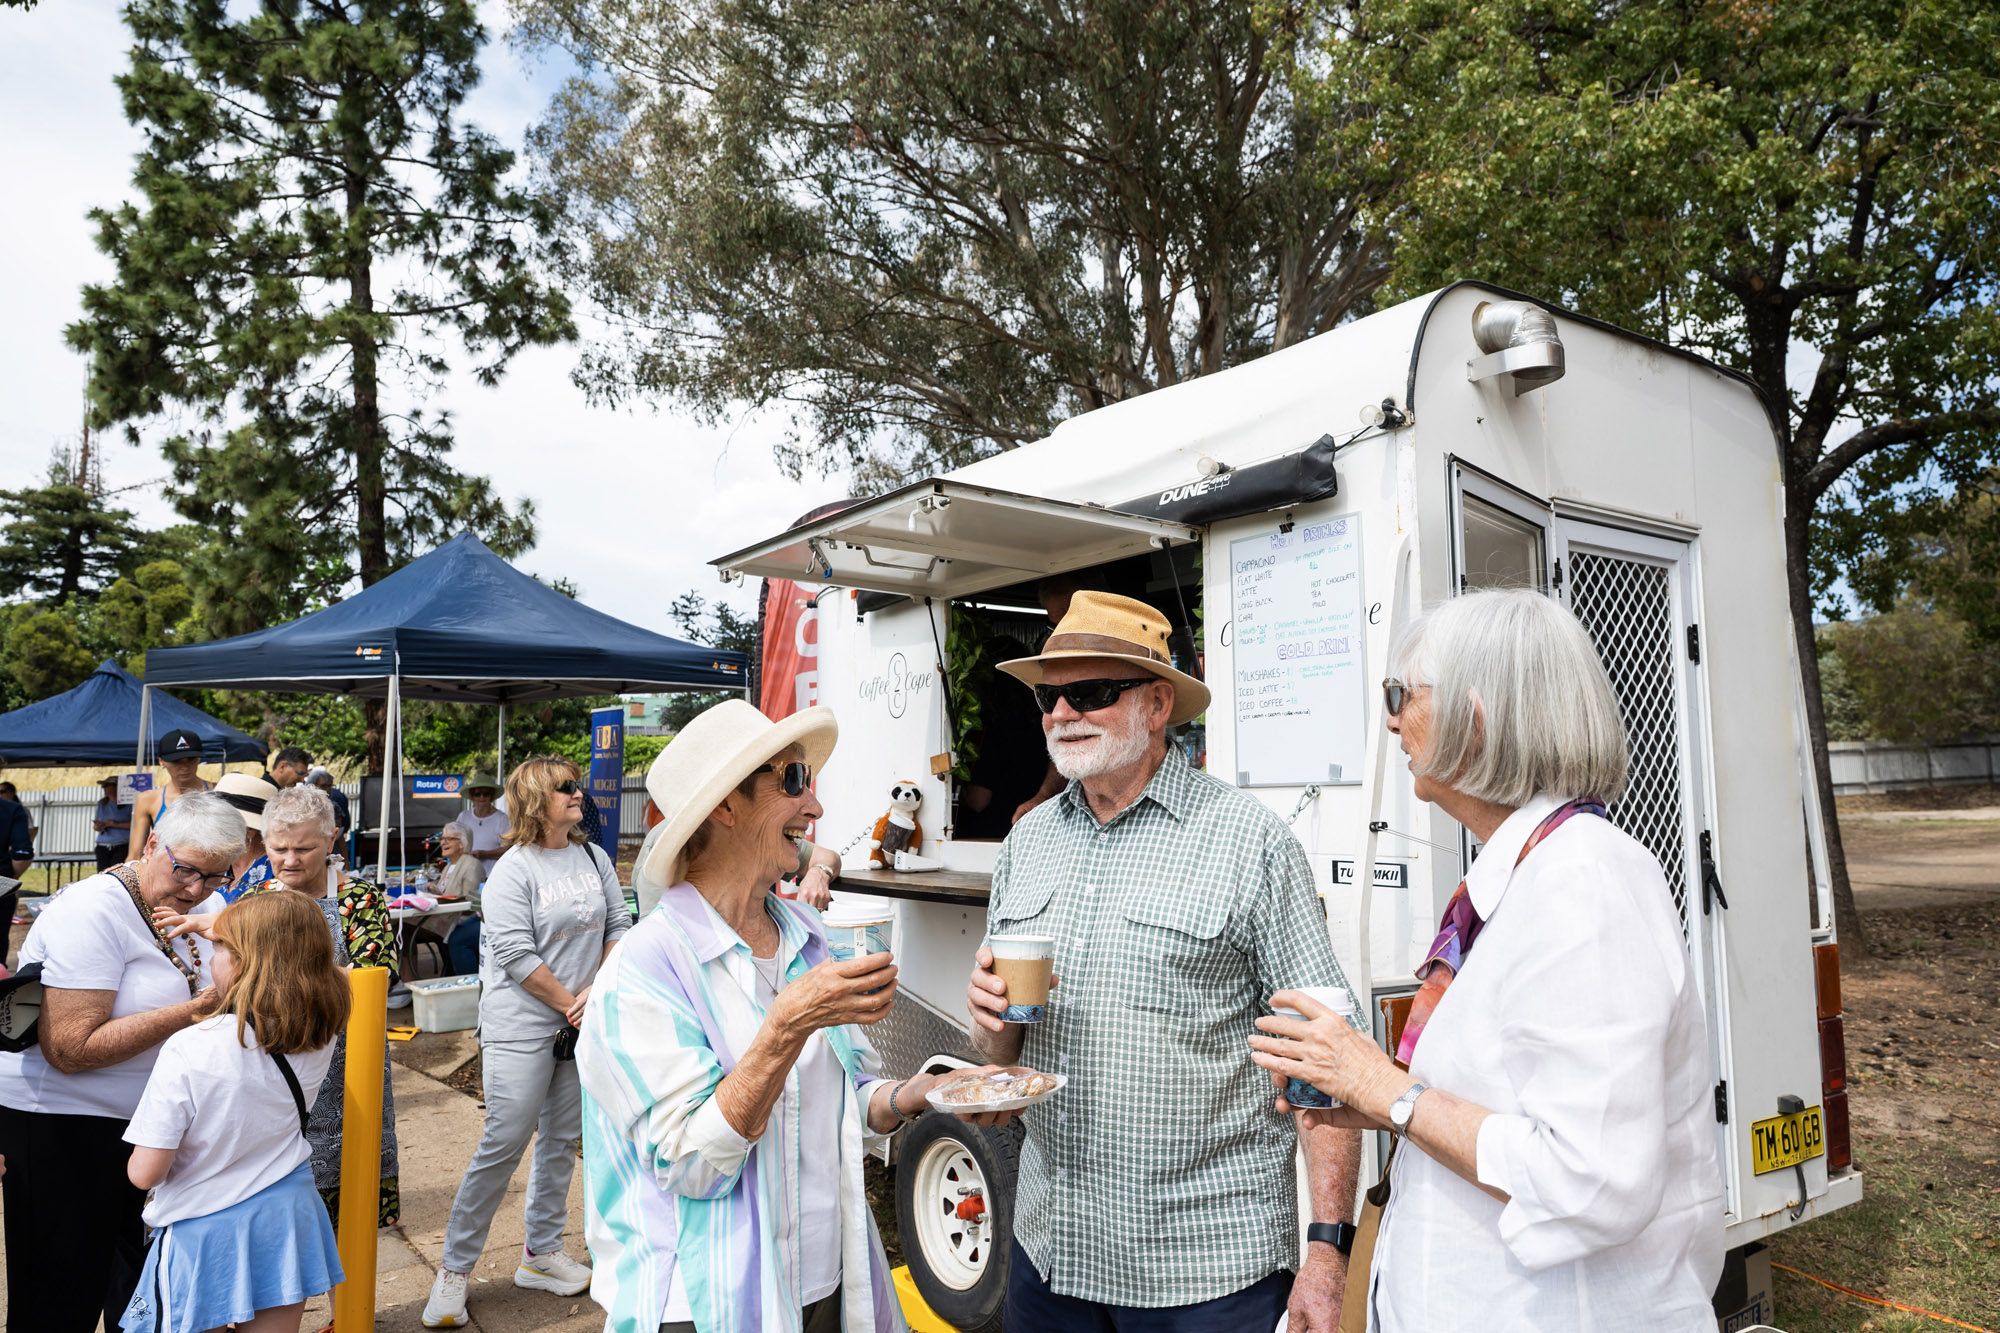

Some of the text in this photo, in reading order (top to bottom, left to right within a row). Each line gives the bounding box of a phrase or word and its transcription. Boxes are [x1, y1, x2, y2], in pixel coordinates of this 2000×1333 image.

[1159, 481, 1209, 505] DUNE
[1304, 520, 1348, 542] DRINKS
[1238, 570, 1272, 587] FLAT WHITE
[1311, 571, 1356, 588] HOT CHOCOLATE
[1238, 586, 1257, 598] LATTE
[1311, 590, 1321, 598] TEA
[1238, 601, 1252, 610] LONG
[1277, 637, 1351, 660] COLD DRIN
[1238, 668, 1281, 682] MILKSHAKES
[1239, 688, 1254, 697] ICED
[1259, 684, 1279, 694] LATTE
[1239, 700, 1255, 711] ICED
[1259, 698, 1284, 708] COFFEE
[416, 780, 442, 790] Rotary
[537, 873, 601, 910] MALIB
